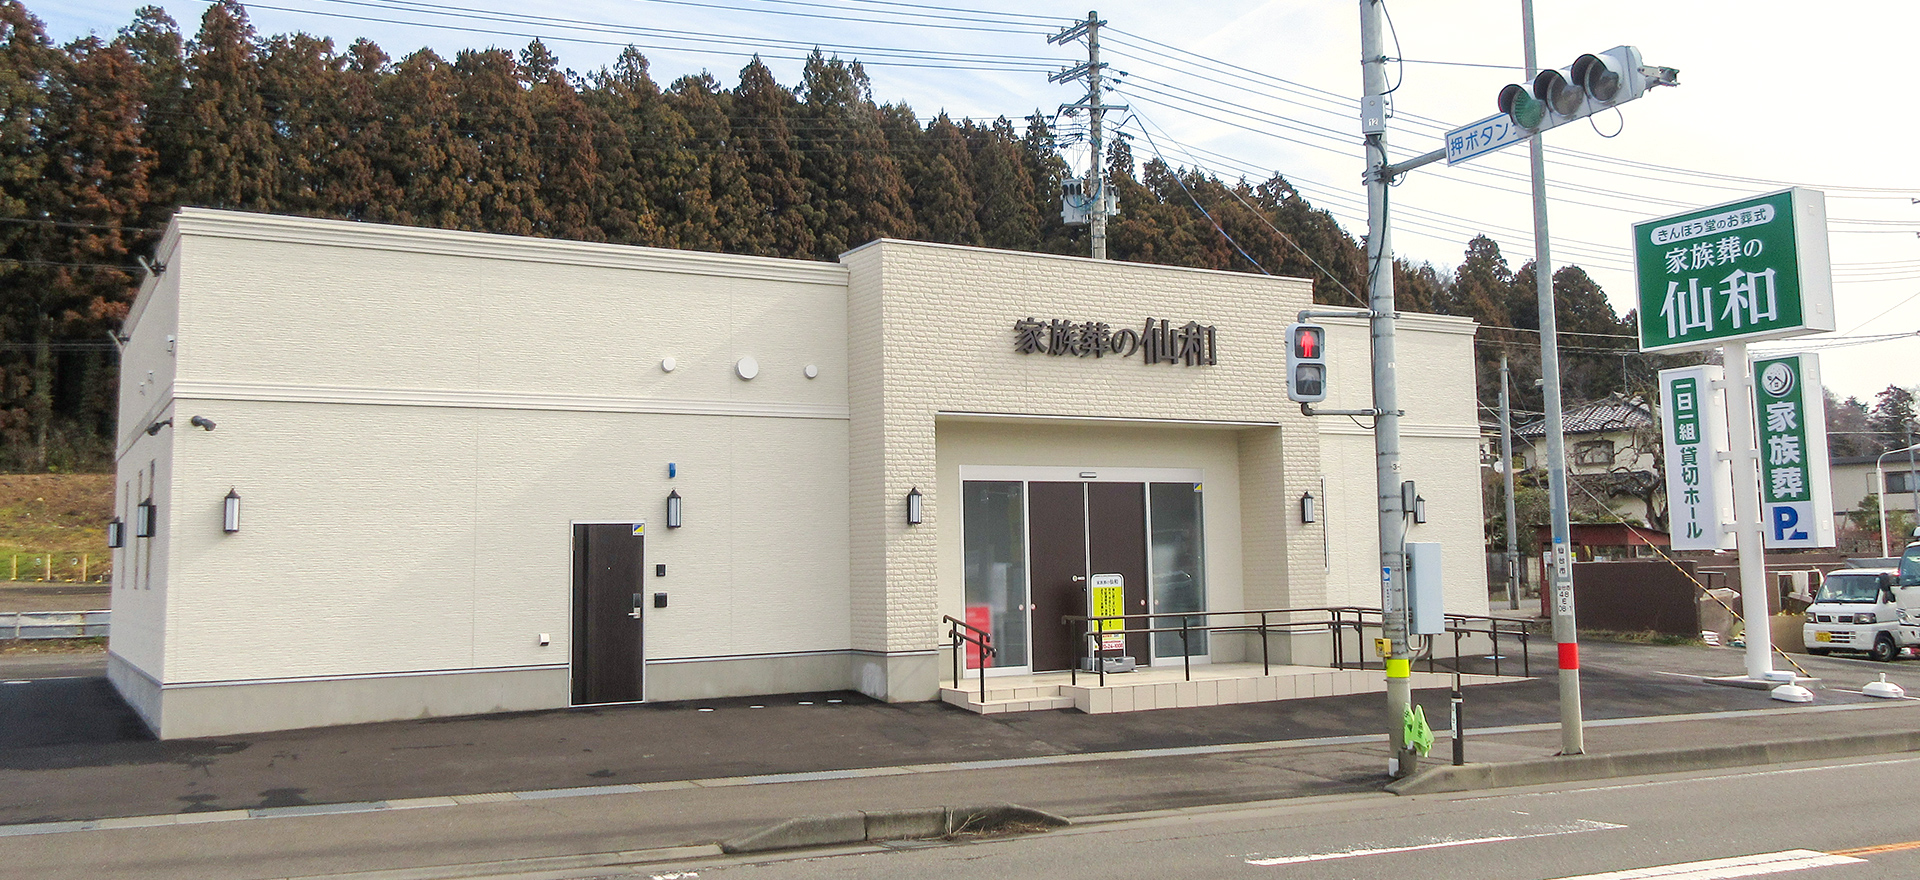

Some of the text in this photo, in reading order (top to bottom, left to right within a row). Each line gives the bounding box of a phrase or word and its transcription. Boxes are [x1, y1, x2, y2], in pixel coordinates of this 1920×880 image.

[1450, 122, 1517, 157] 押ボタン
[1664, 236, 1763, 275] 家族葬の
[1660, 267, 1777, 338] 仙和
[1014, 317, 1218, 367] 家族葬の仙和
[1675, 383, 1696, 441] 一日一組
[1766, 401, 1803, 499] 家族葬
[1680, 446, 1703, 539] 貸切ホール
